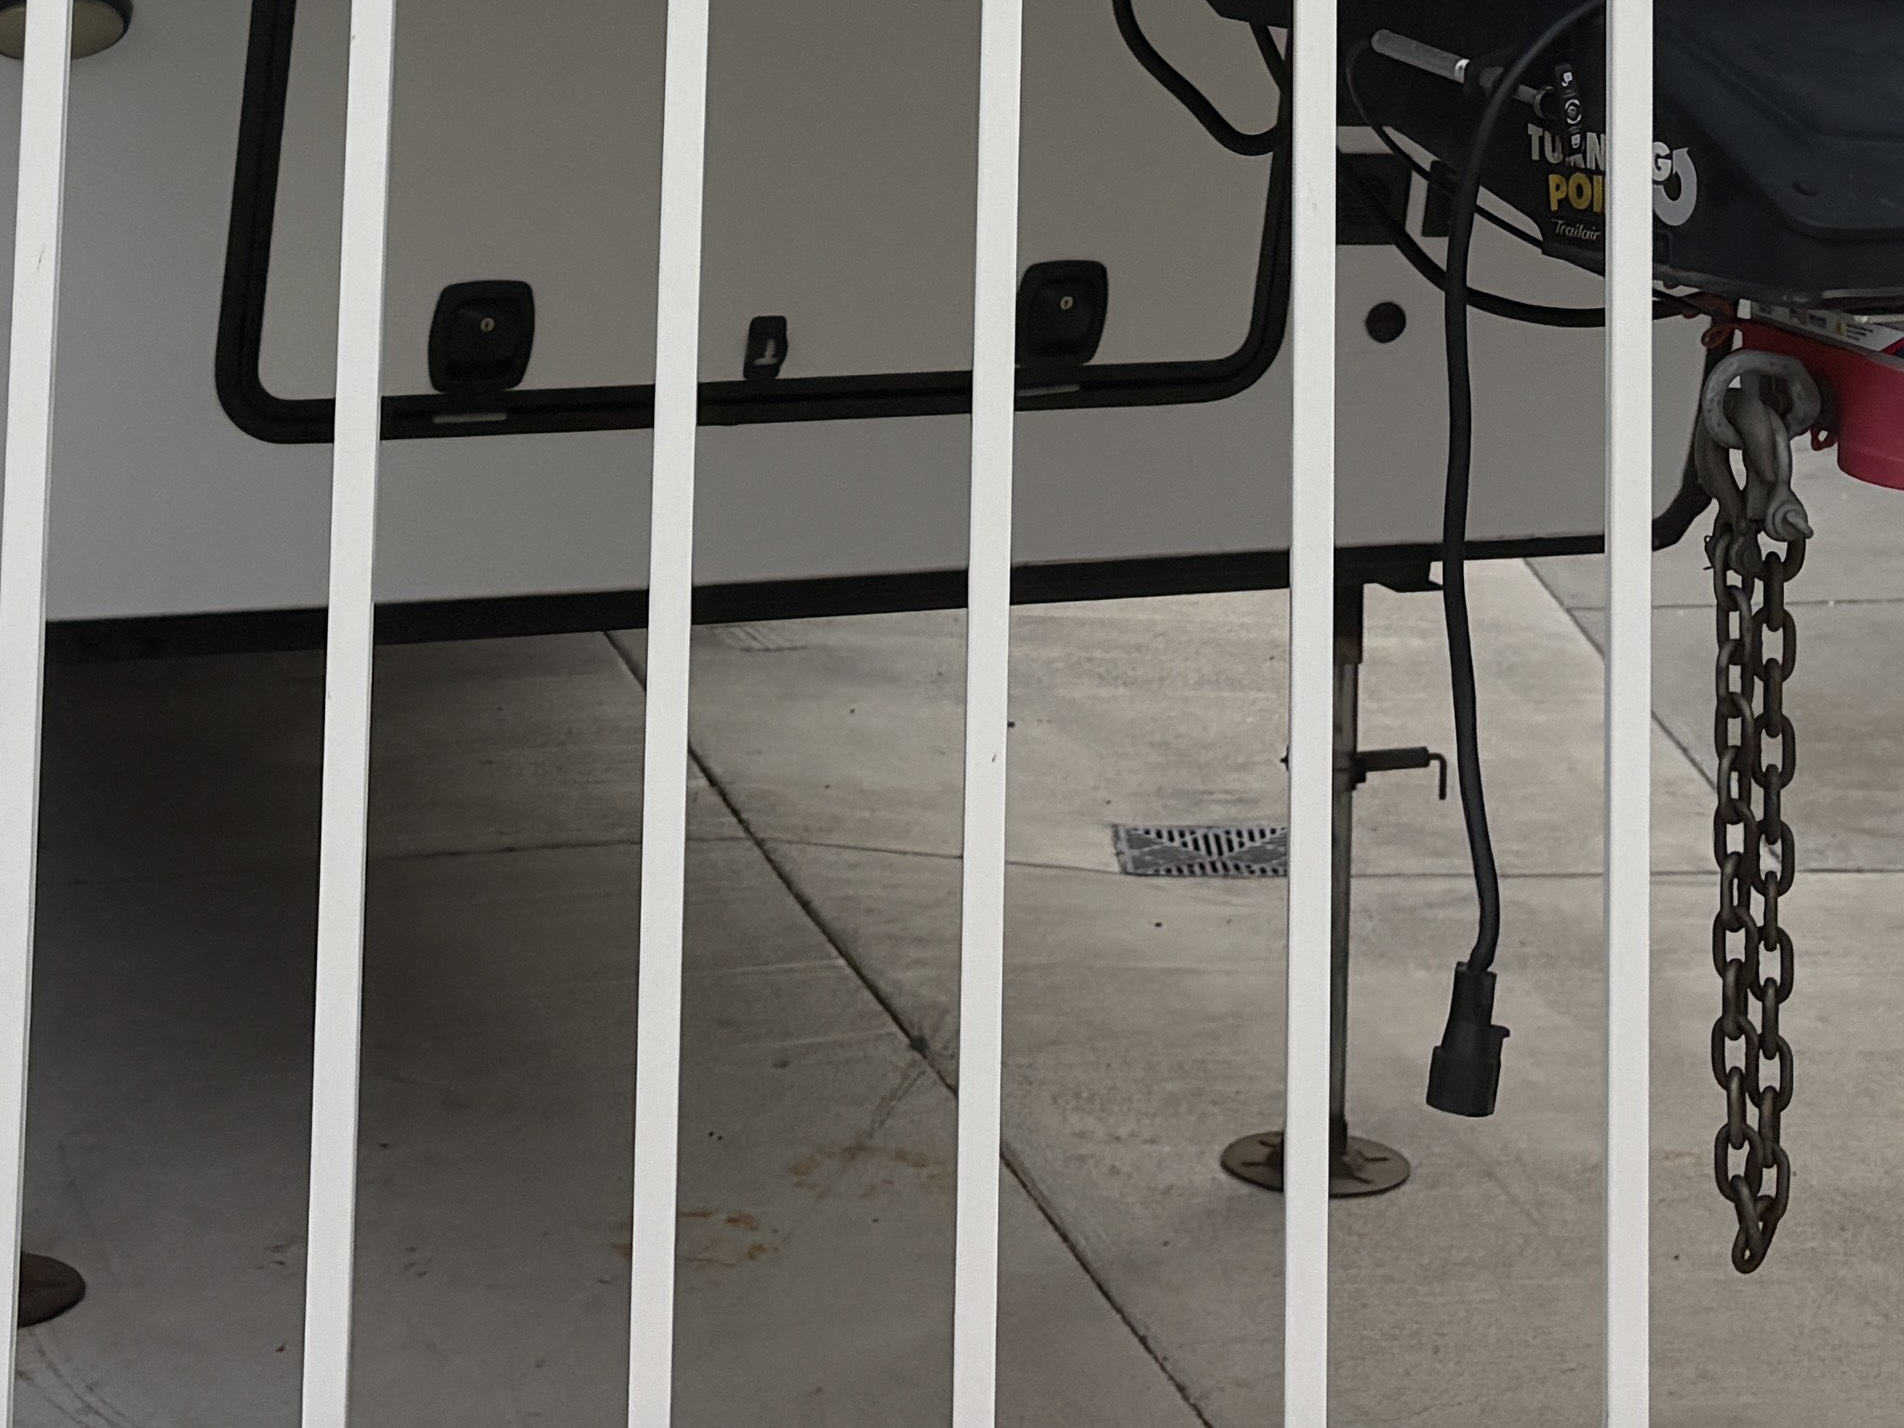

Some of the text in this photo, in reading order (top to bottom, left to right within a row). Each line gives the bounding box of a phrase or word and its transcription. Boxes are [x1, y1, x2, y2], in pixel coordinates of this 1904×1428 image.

[1527, 123, 1672, 182] TUNG
[1548, 172, 1607, 214] POI
[1552, 219, 1602, 241] Trailair
